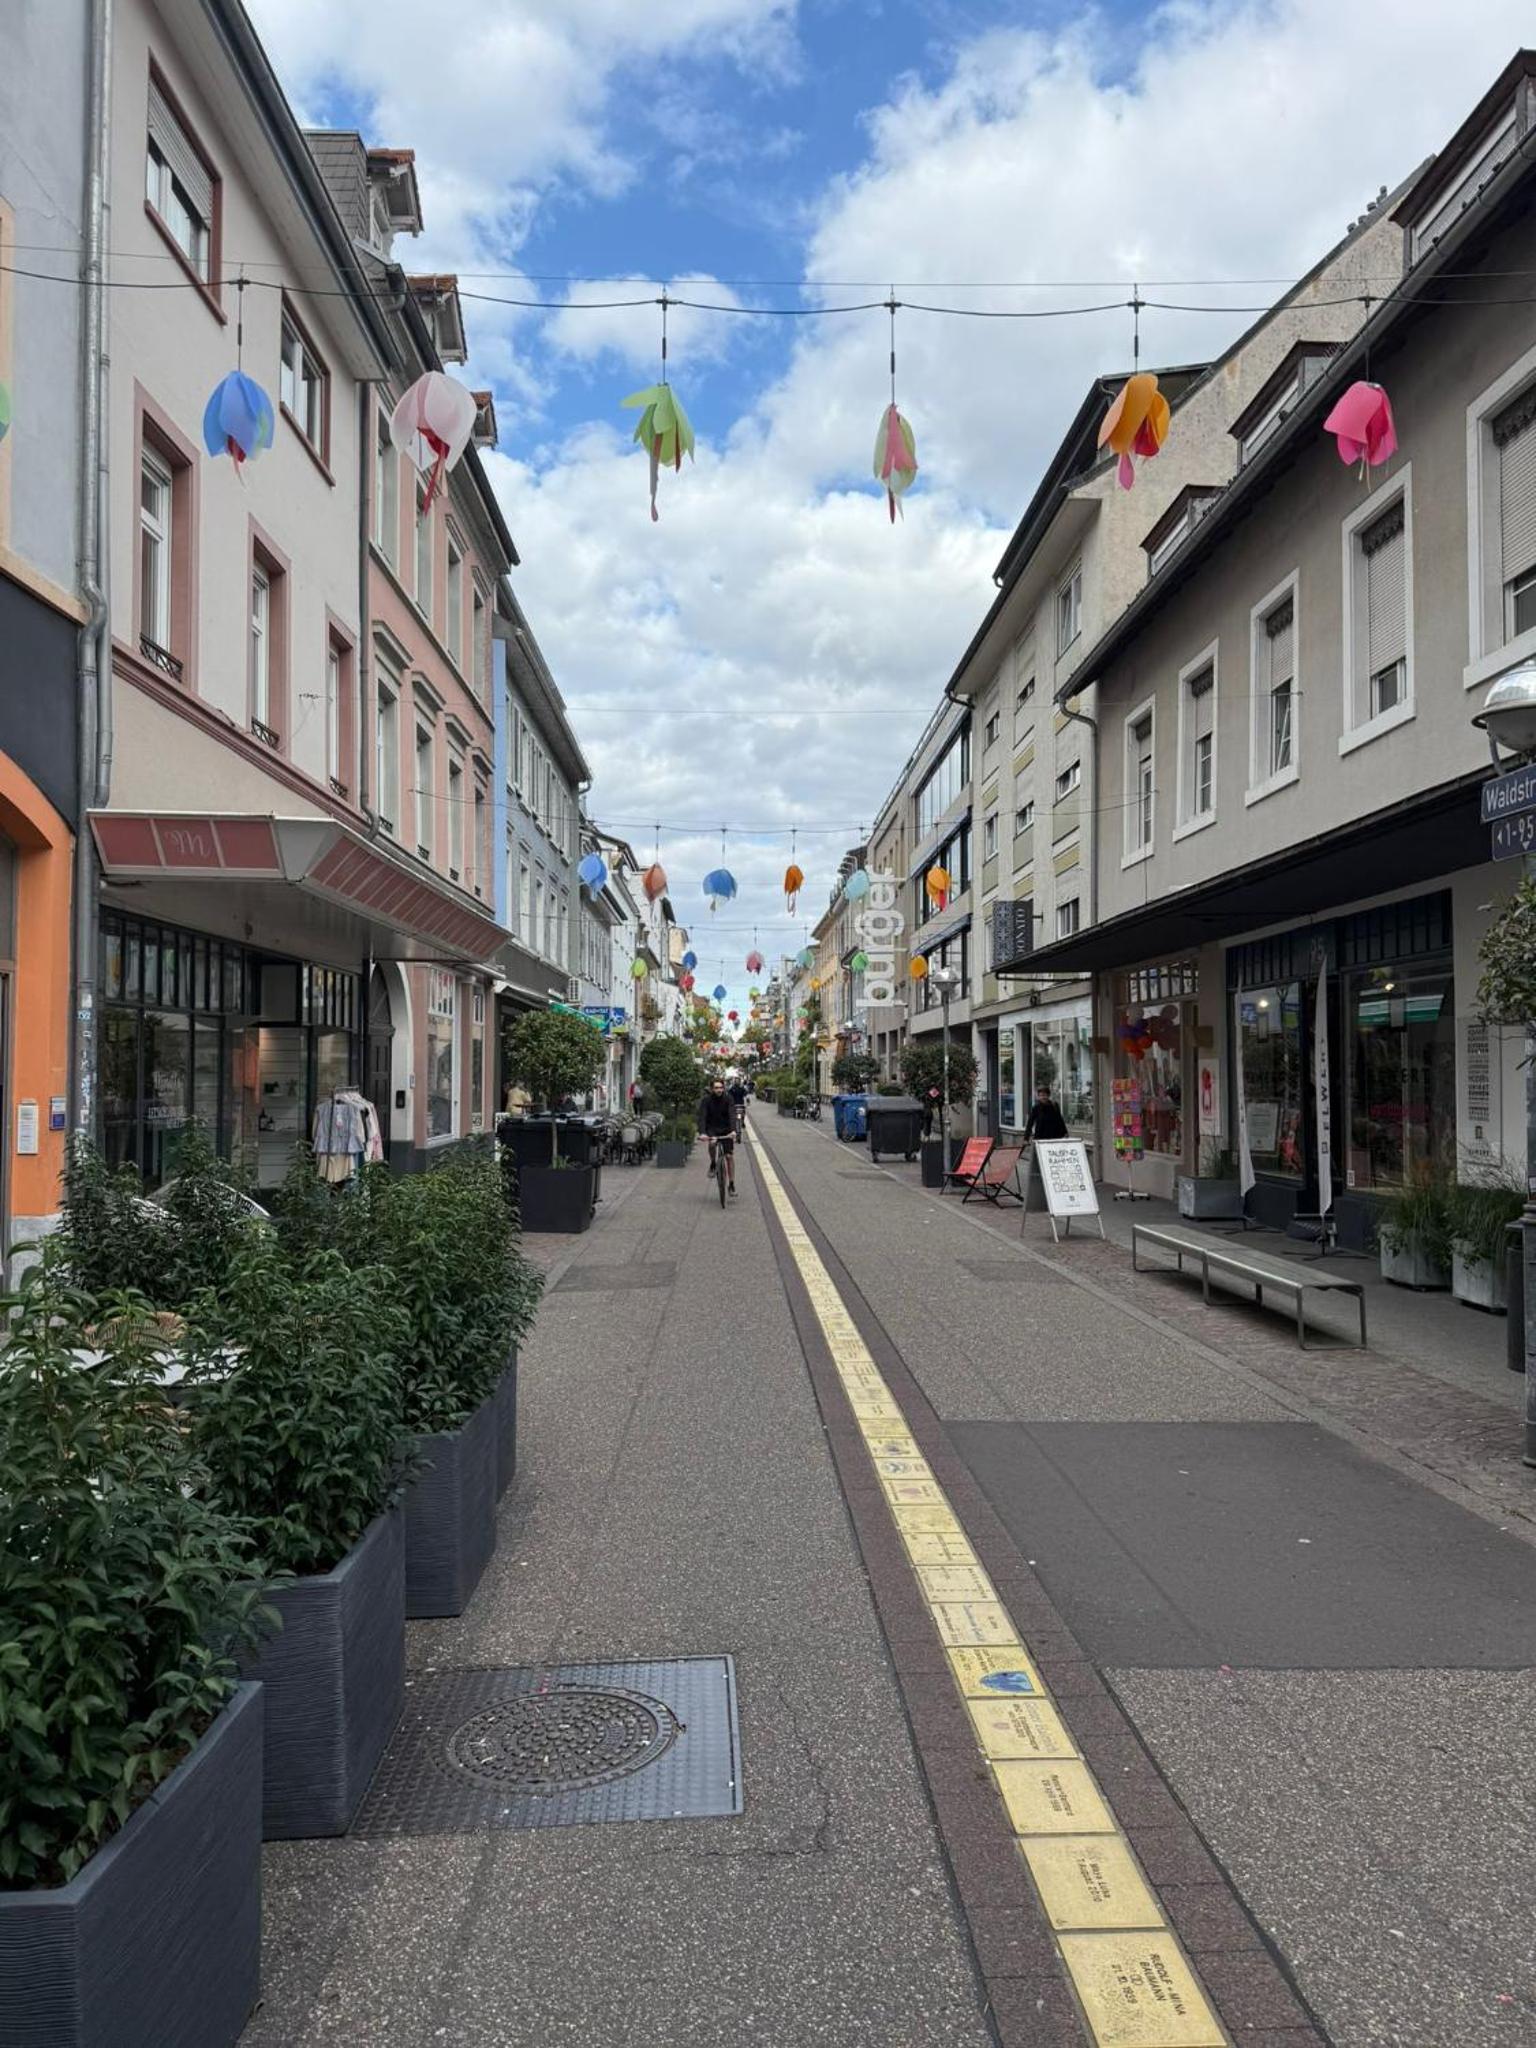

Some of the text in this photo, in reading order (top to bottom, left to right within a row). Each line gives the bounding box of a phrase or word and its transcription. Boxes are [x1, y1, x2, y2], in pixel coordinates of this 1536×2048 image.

[855, 864, 905, 1007] burger
[1139, 1961, 1167, 2001] BAUMANN
[1150, 1953, 1173, 1985] RUDOLF
[1169, 1993, 1186, 2016] MINA
